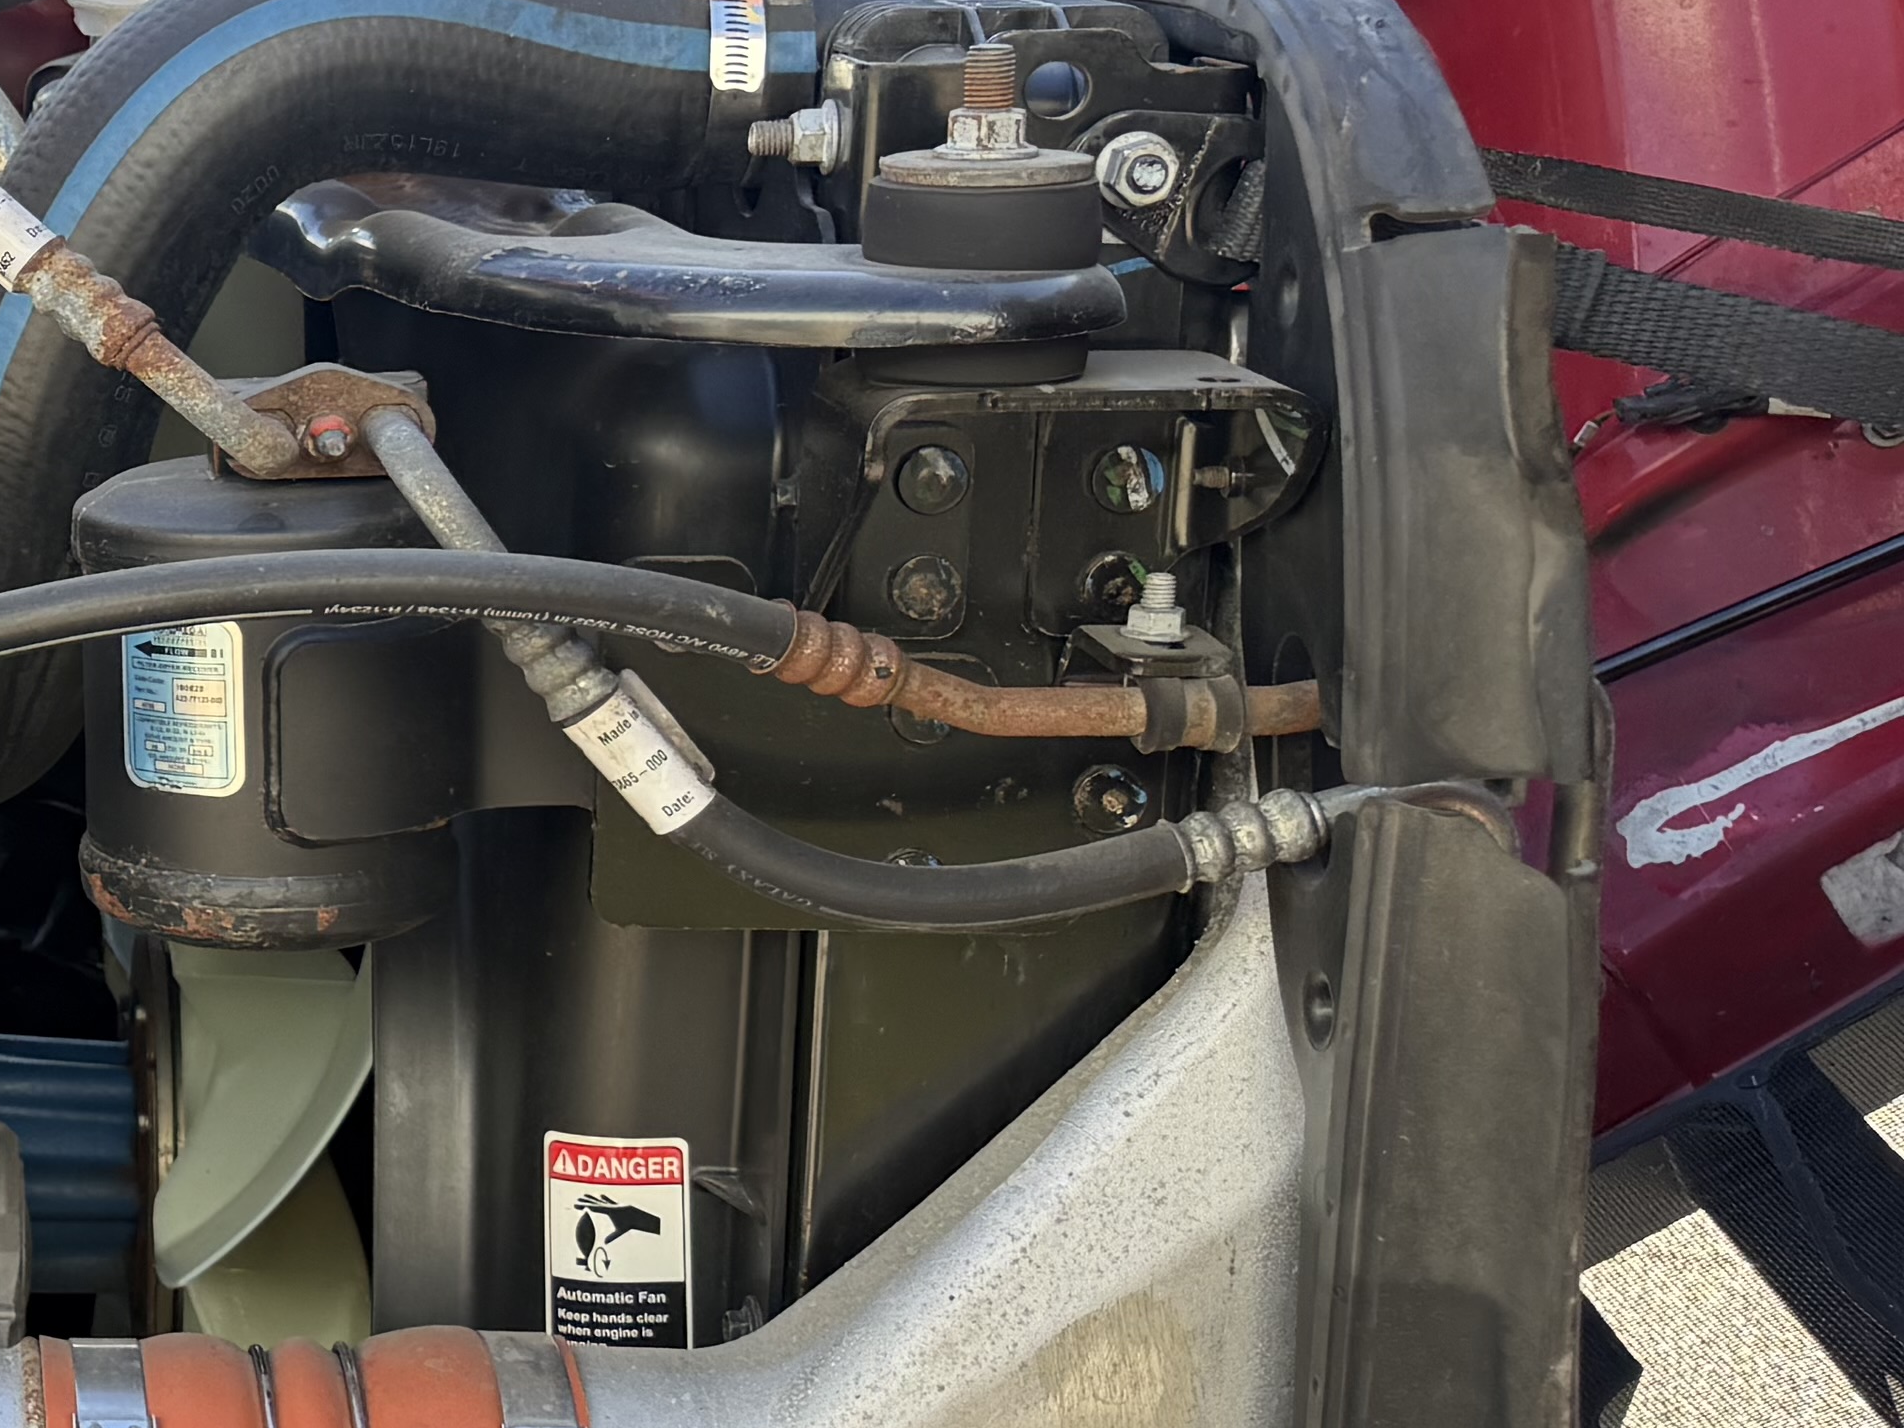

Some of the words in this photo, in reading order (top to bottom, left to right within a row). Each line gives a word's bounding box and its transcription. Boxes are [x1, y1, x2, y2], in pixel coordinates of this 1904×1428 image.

[623, 624, 674, 640] HOSE
[675, 634, 707, 646] A/C
[597, 718, 632, 747] Made
[661, 791, 696, 817] Date:
[577, 1155, 680, 1179] DANGER
[557, 1287, 634, 1304] Automatic
[639, 1291, 666, 1304] Fan
[558, 1307, 589, 1323] Keep
[593, 1312, 633, 1324] hands
[636, 1312, 669, 1323] clear
[558, 1325, 591, 1337] when
[594, 1327, 638, 1340] engine
[642, 1326, 653, 1338] is
